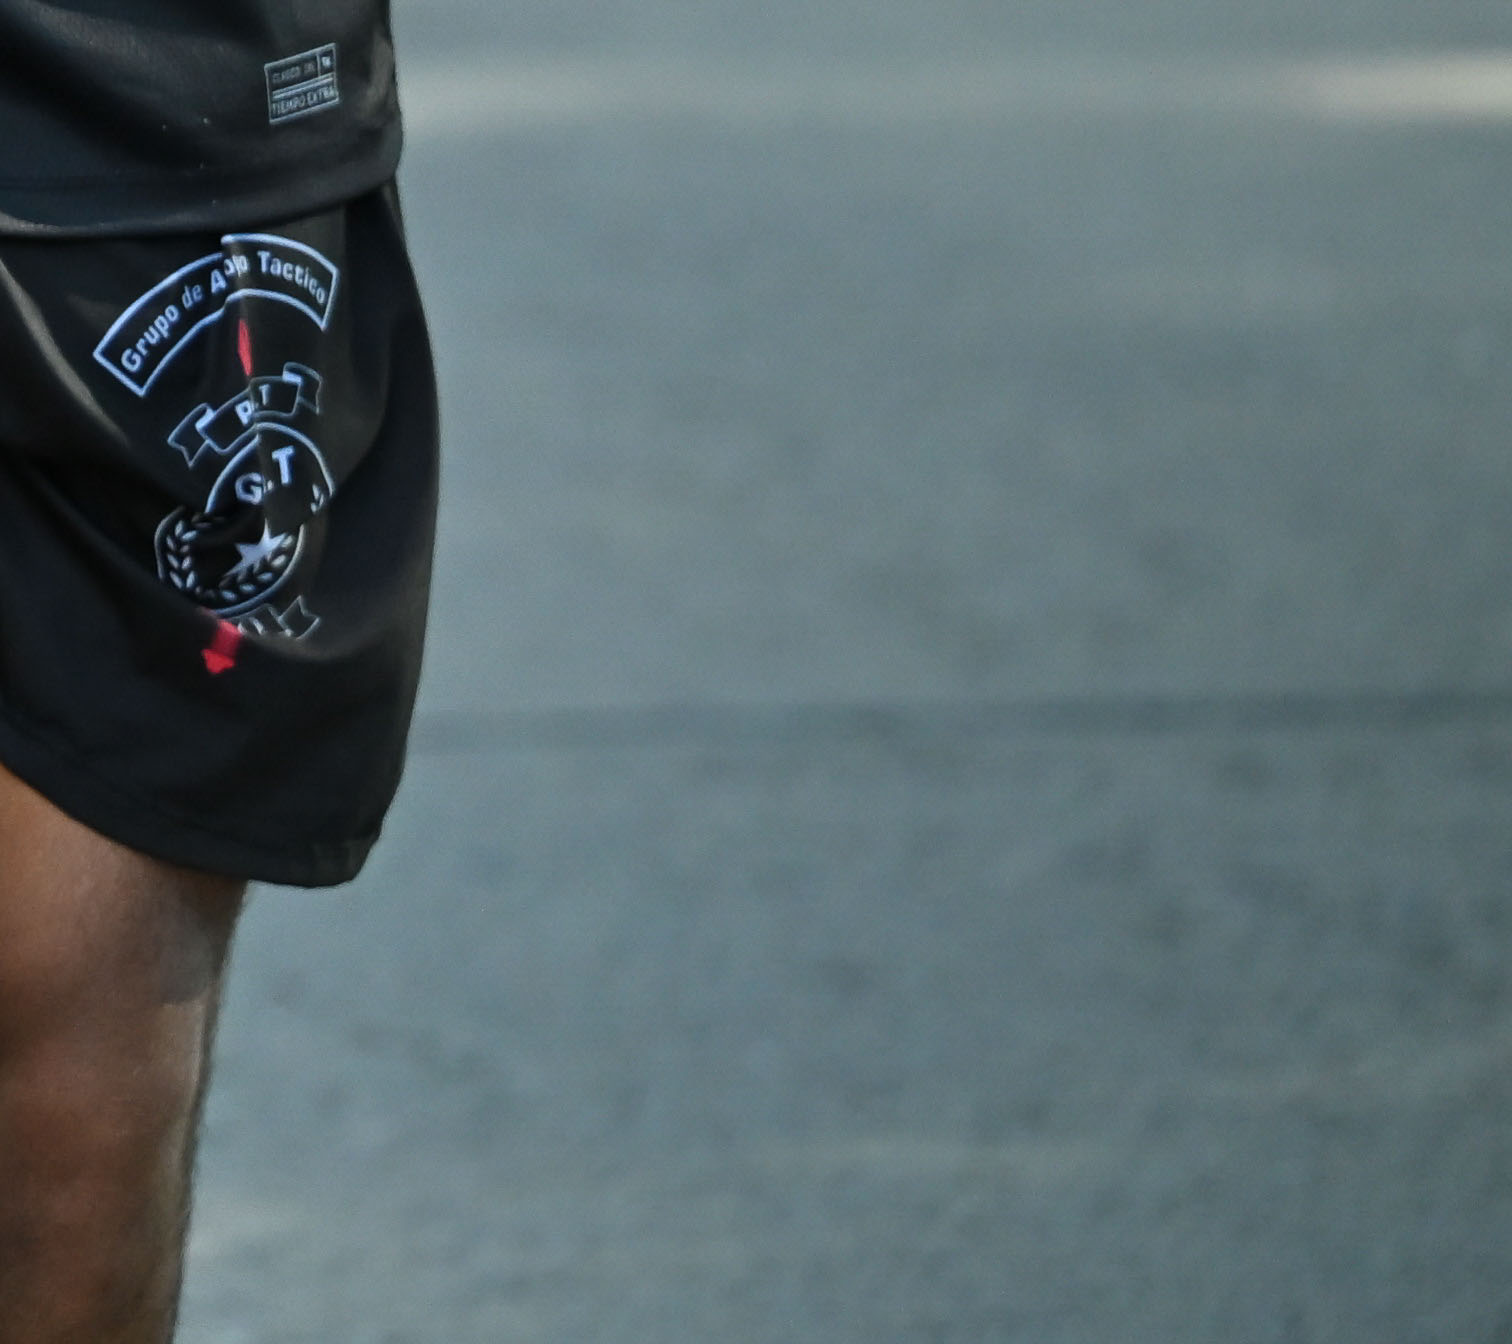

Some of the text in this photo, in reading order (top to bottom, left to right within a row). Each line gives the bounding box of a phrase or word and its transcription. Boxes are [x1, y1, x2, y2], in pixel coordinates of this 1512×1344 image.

[120, 304, 181, 374] Grupo
[181, 283, 204, 310] de
[257, 249, 327, 305] Tactico
